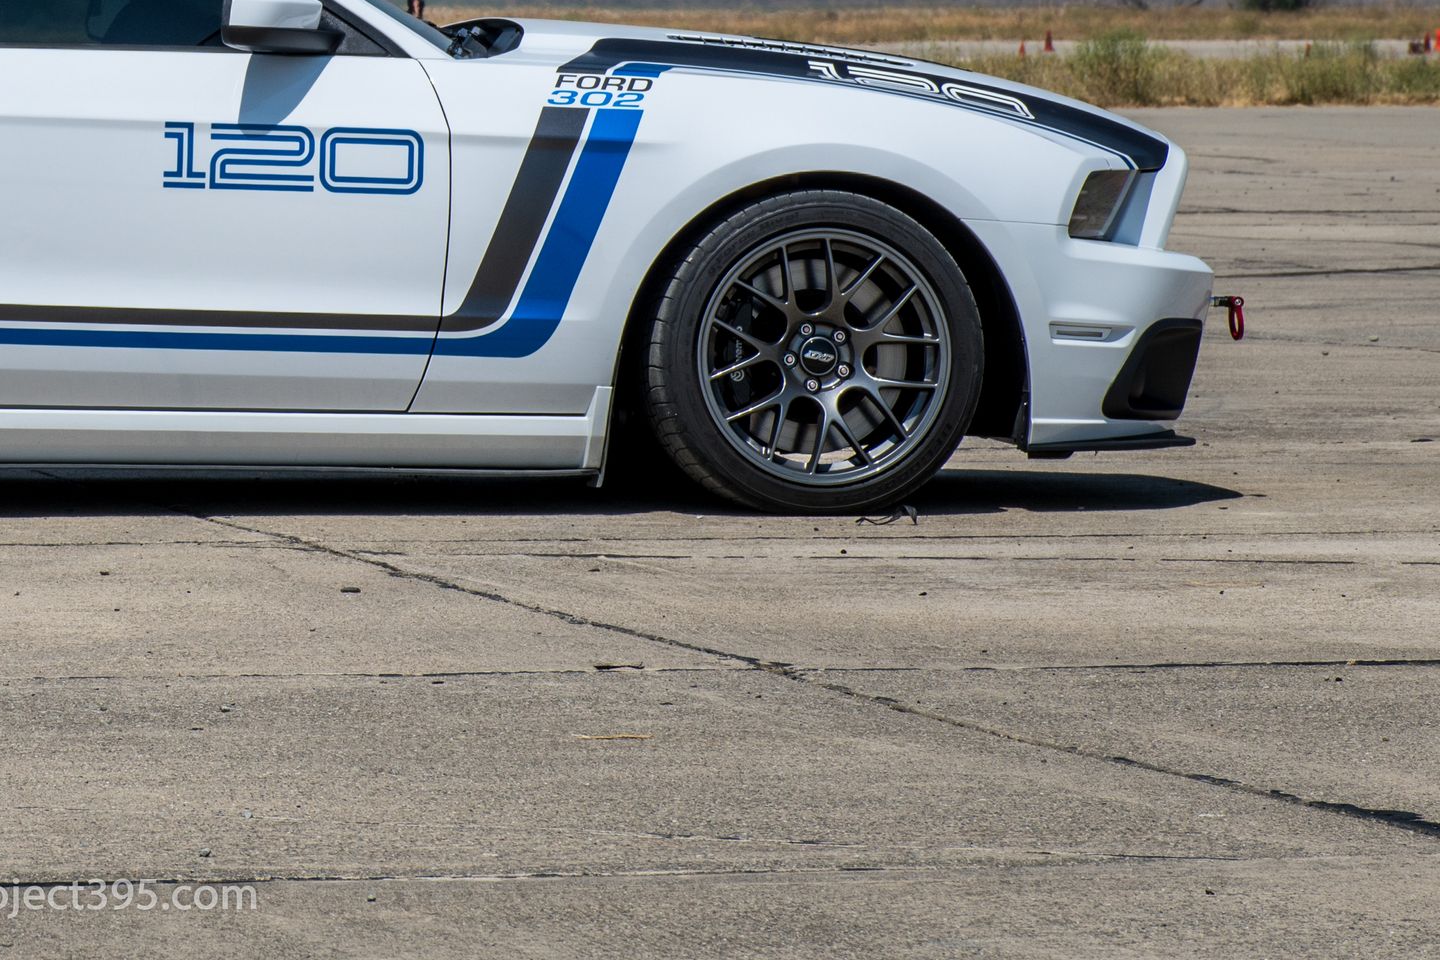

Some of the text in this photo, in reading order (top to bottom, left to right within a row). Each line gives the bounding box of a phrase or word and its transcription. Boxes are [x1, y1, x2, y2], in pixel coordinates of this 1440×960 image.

[555, 74, 653, 92] FORD
[547, 90, 645, 108] 302
[163, 121, 424, 195] 120
